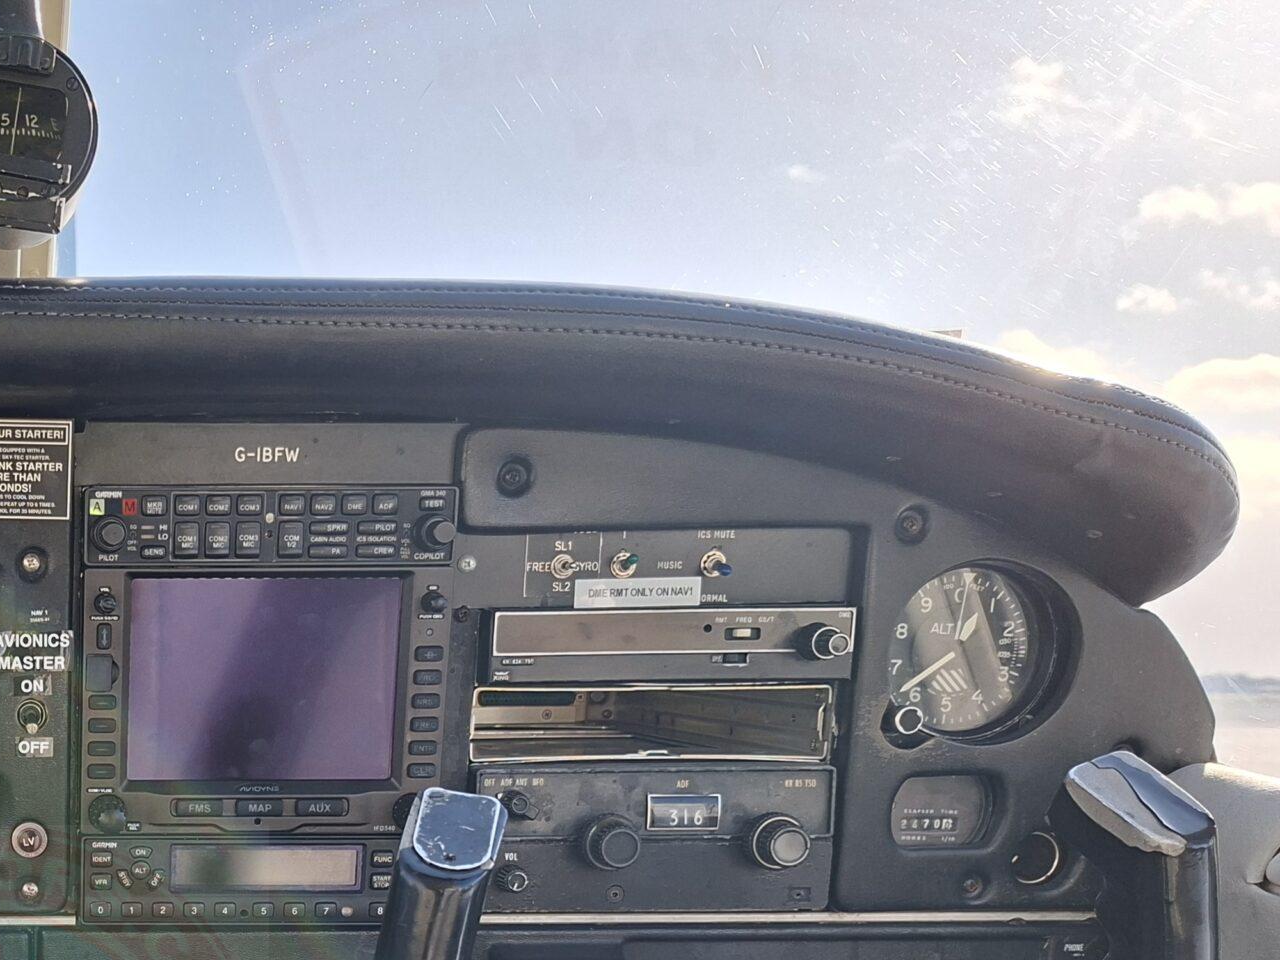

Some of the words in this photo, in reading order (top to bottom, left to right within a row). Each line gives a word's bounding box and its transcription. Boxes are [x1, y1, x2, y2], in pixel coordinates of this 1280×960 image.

[26, 114, 40, 128] 12
[14, 429, 64, 440] STARTER!
[234, 446, 300, 462] G-IBFW
[15, 462, 63, 472] STARTER
[13, 473, 41, 482] THAN
[714, 530, 736, 539] MUTE
[554, 541, 573, 551] SL1
[526, 563, 550, 572] FREE
[657, 561, 683, 570] MUSIC
[552, 582, 571, 592] SL2
[588, 588, 608, 598] DME
[609, 588, 629, 597] RMT
[630, 587, 655, 597] ONLY
[656, 586, 670, 596] ON
[671, 586, 693, 596] NAV1
[701, 593, 728, 603] ORMAL
[929, 622, 953, 635] ALT
[20, 680, 44, 692] ON
[18, 741, 50, 753] OFF
[188, 803, 212, 814] FMS
[248, 803, 273, 814] MAP
[308, 803, 332, 814] AUX
[669, 809, 704, 826] 316
[21, 836, 36, 847] LV
[92, 855, 112, 863] IDENT
[373, 855, 392, 863] FUNC
[504, 852, 518, 861] VOL
